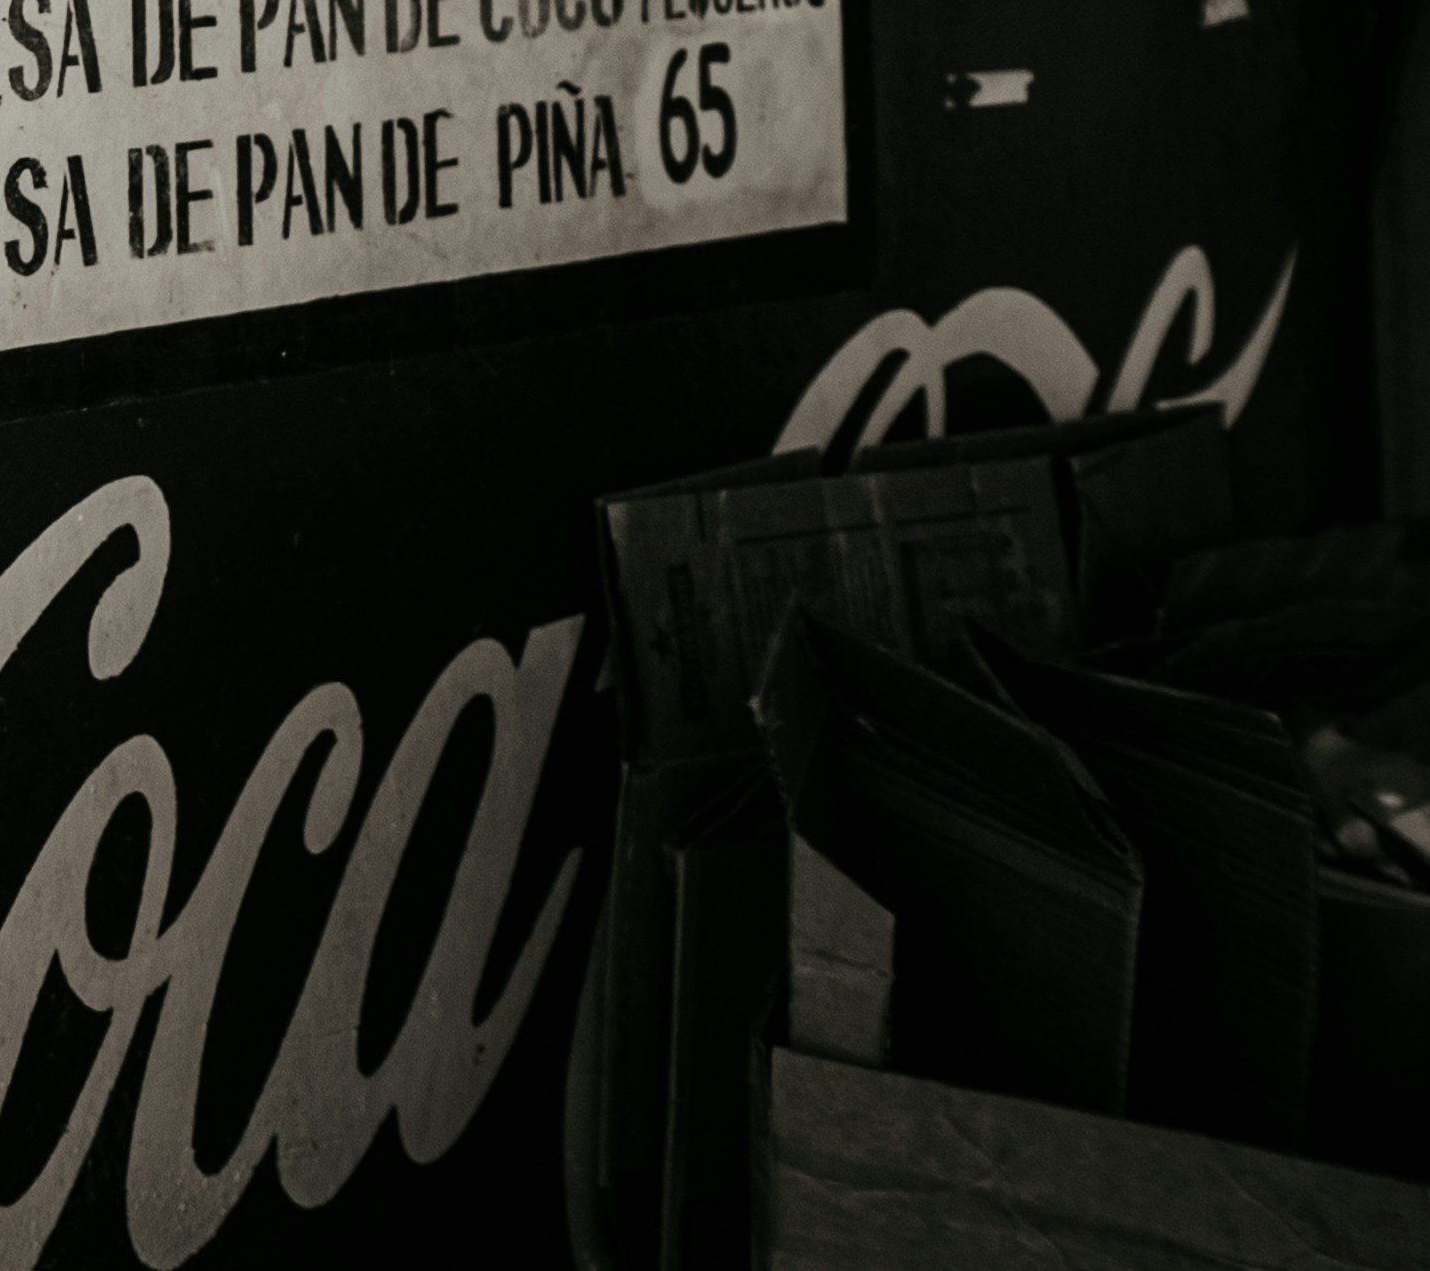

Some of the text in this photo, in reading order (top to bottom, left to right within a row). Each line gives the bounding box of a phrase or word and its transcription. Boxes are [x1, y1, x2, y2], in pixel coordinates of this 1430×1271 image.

[127, 137, 215, 260] DE
[235, 121, 364, 248] PAN
[381, 107, 461, 227] DE
[496, 79, 628, 209] PIÑA
[659, 41, 738, 185] 65
